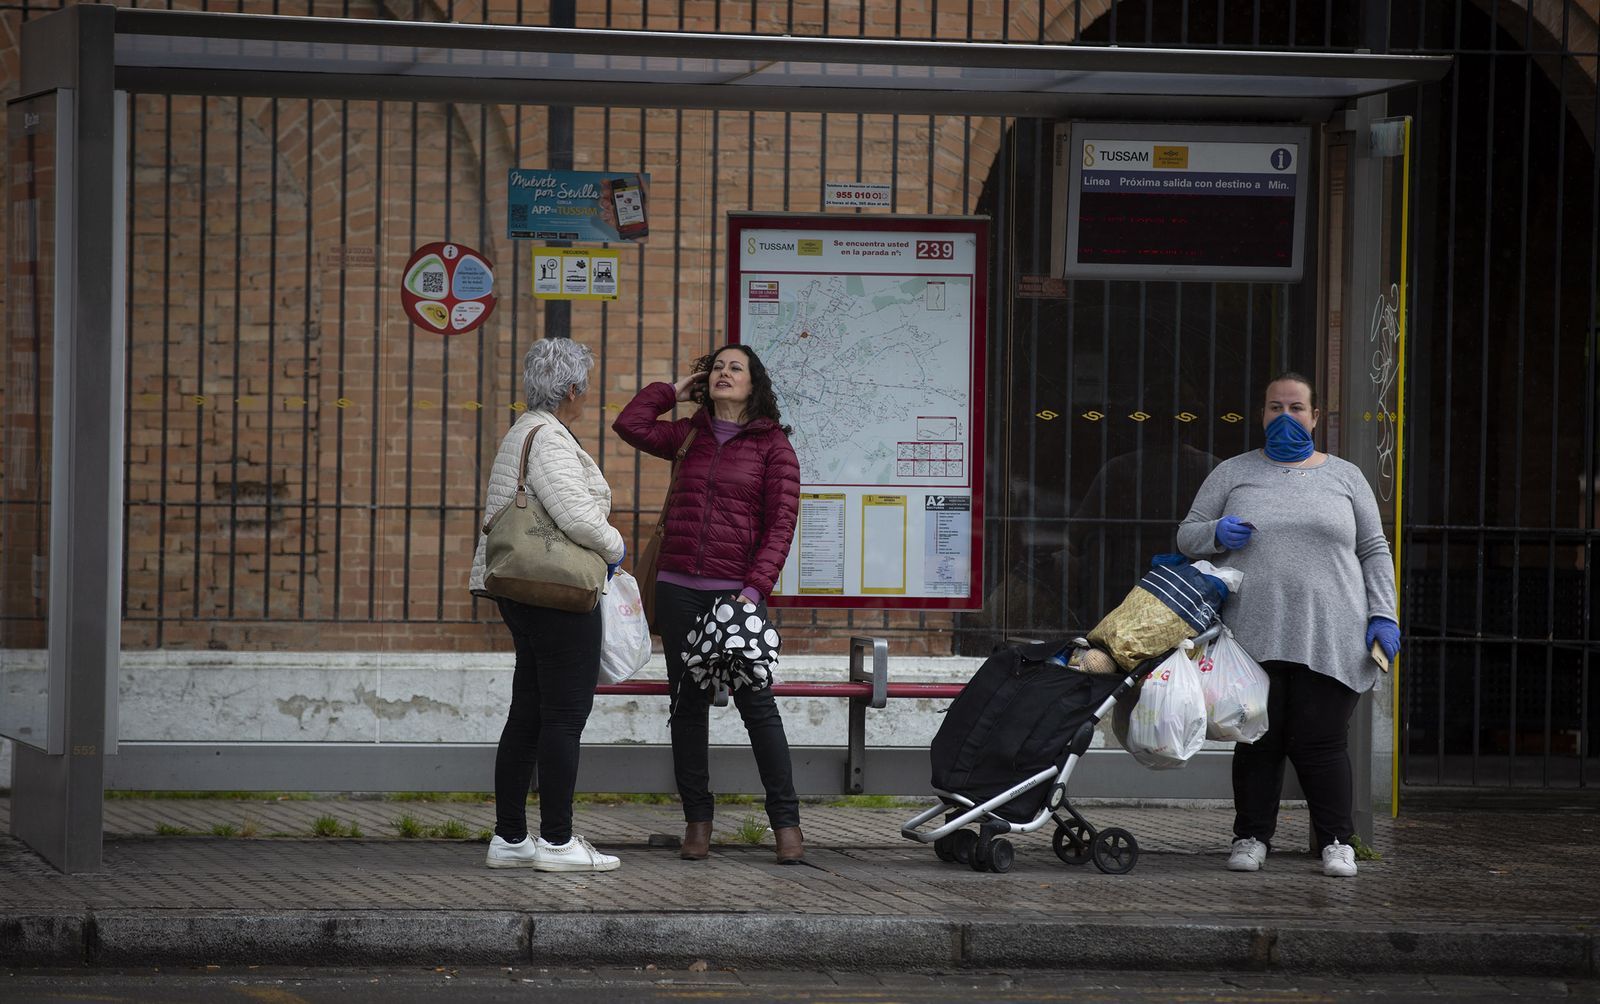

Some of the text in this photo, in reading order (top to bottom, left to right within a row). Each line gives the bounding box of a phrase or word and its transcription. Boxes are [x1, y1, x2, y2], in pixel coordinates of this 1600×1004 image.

[1100, 151, 1149, 162] TUSSAM
[511, 172, 557, 188] Muévete
[1084, 176, 1111, 186] Línea
[1119, 177, 1161, 188] Próxima
[1163, 178, 1193, 188] salida
[1215, 179, 1252, 189] destino
[1268, 181, 1290, 190] Min.
[534, 183, 600, 201] por Sevilla
[531, 205, 551, 215] APP
[557, 206, 599, 216] TUSSAM
[760, 243, 795, 251] TUSSAM
[846, 240, 886, 248] encuentra
[917, 242, 953, 258] 239
[862, 249, 889, 257] parada
[926, 495, 944, 506] A2
[72, 745, 97, 756] 552
[1009, 779, 1037, 797] playmarket
